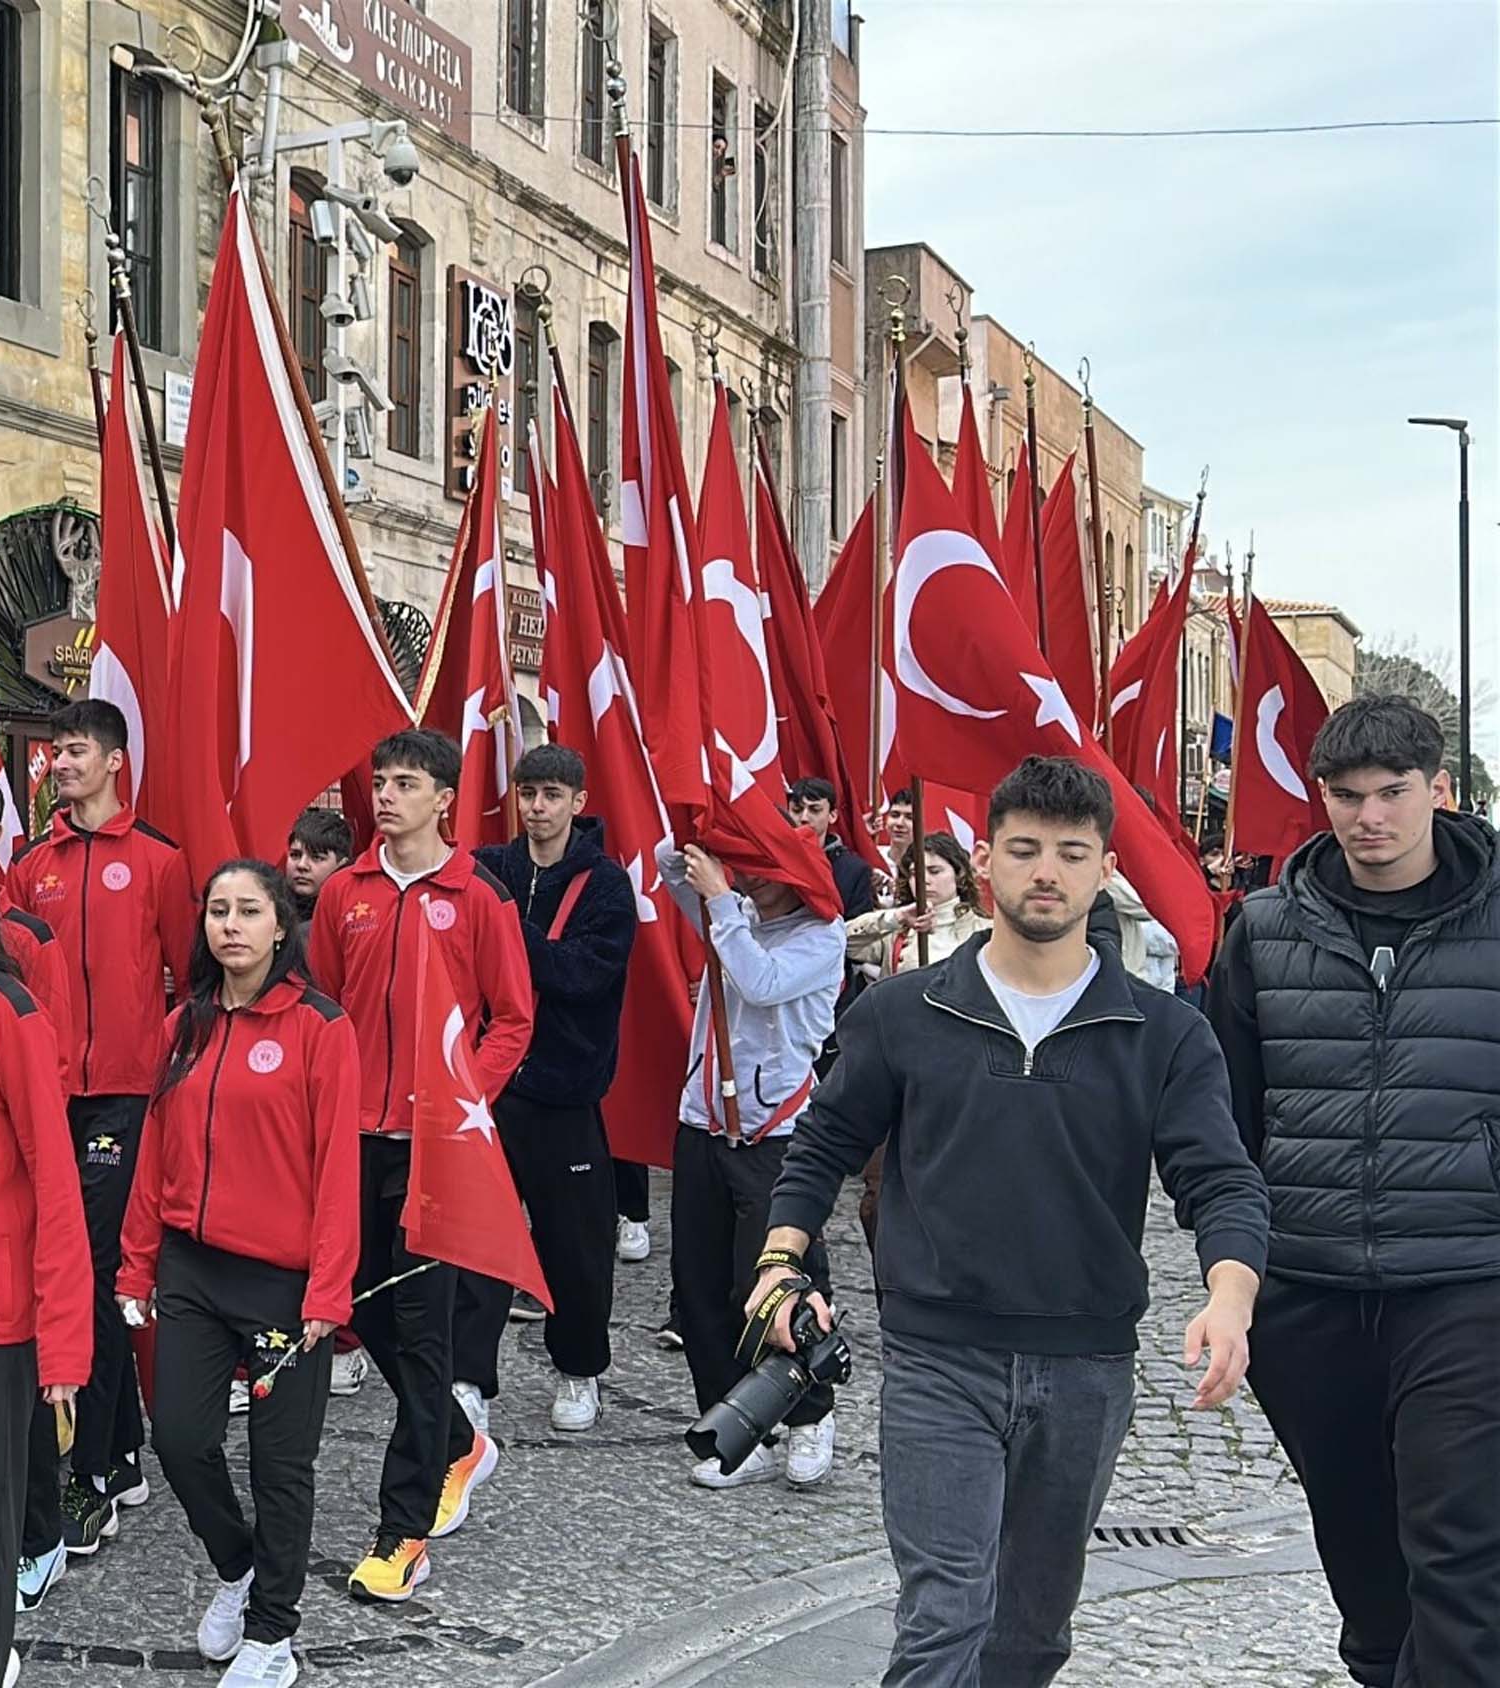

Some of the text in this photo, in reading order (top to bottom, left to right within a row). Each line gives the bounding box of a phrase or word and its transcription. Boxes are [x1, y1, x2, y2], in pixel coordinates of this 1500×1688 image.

[363, 0, 462, 91] KALE MÜPTELA
[376, 51, 452, 127] OCAKBAŞI
